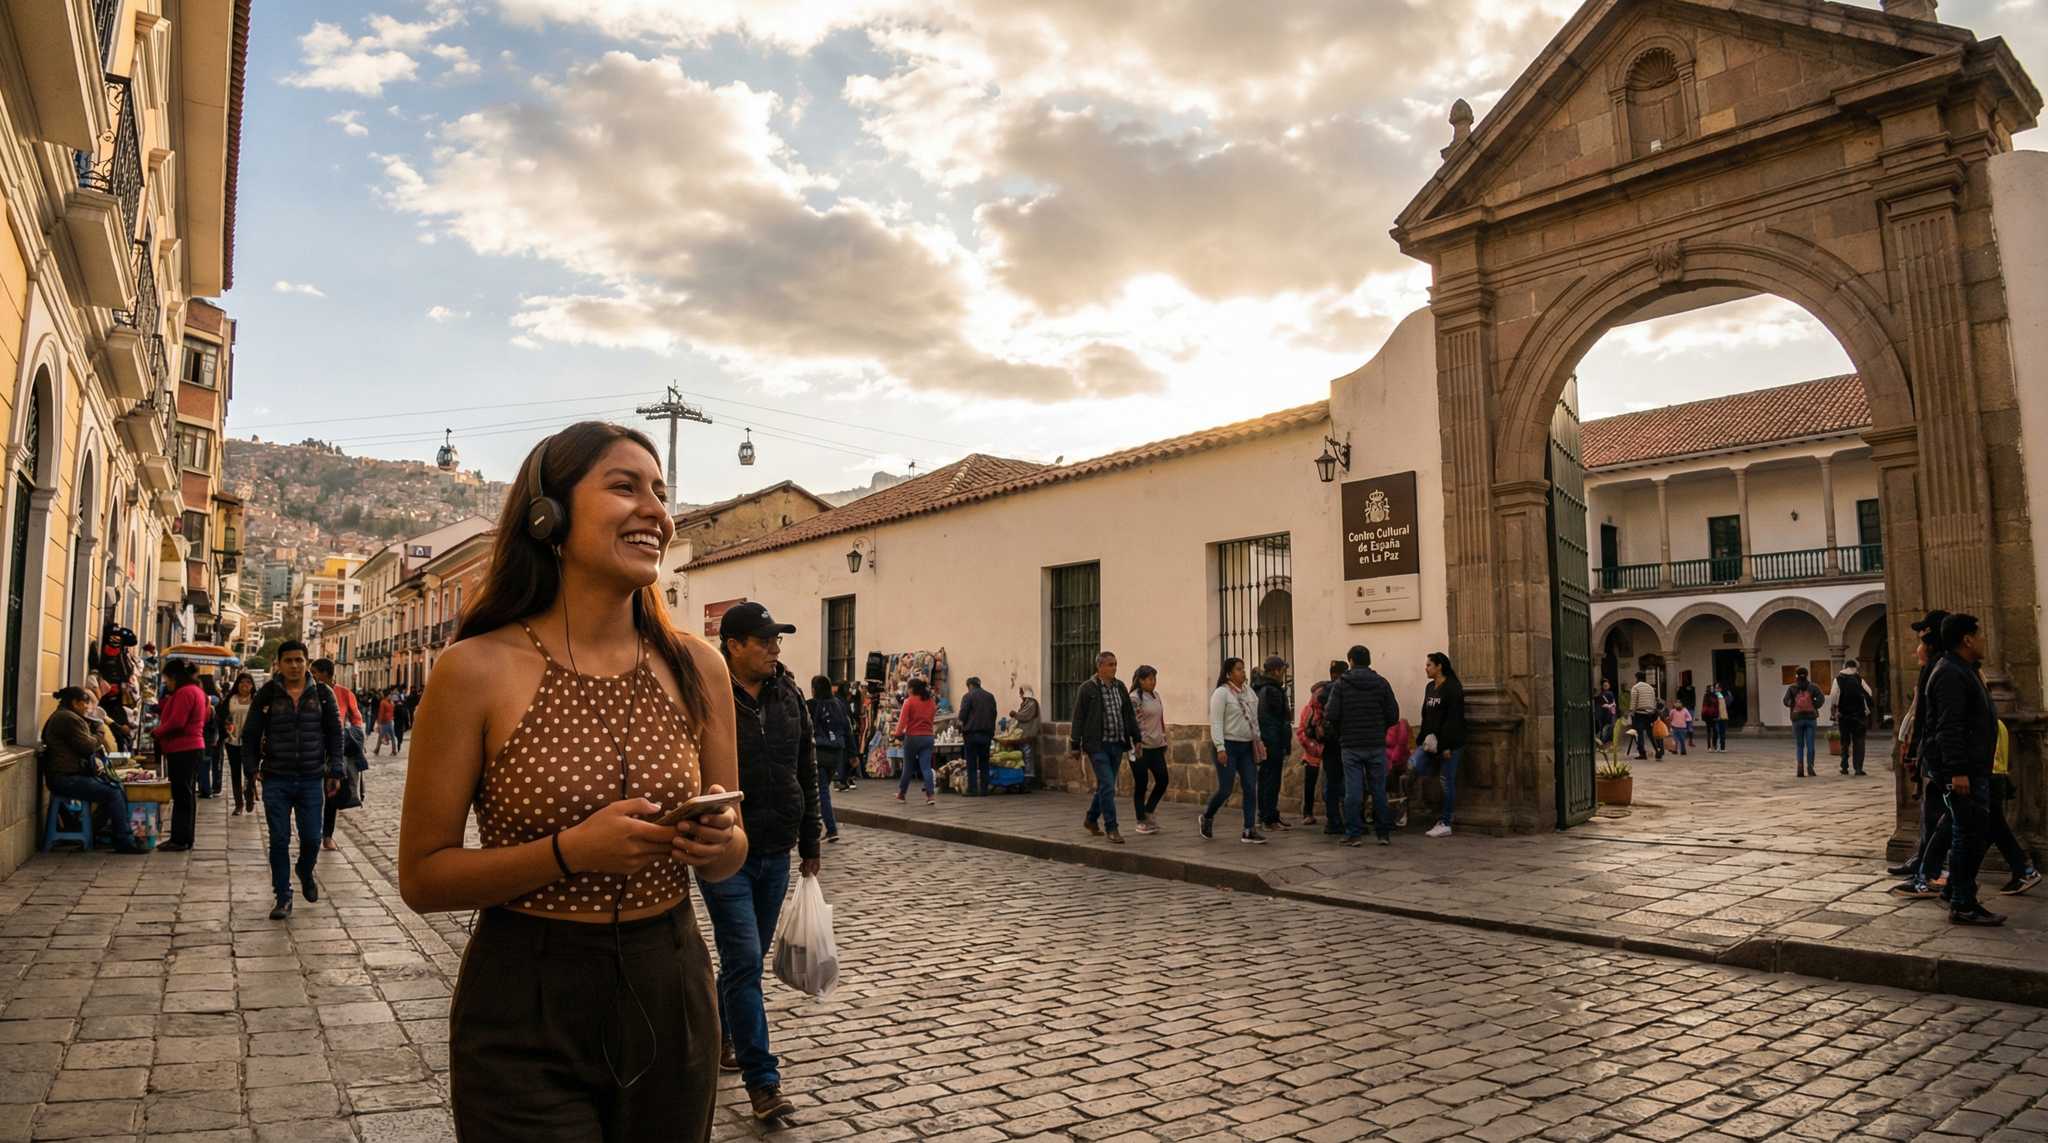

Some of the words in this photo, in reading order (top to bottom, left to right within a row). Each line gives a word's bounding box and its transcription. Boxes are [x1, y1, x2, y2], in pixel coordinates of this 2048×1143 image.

[1376, 524, 1410, 538] Cultural
[1358, 542, 1368, 552] de
[1370, 538, 1400, 551] España
[1359, 555, 1370, 564] en
[1371, 553, 1382, 562] La
[1384, 551, 1399, 561] Paz
